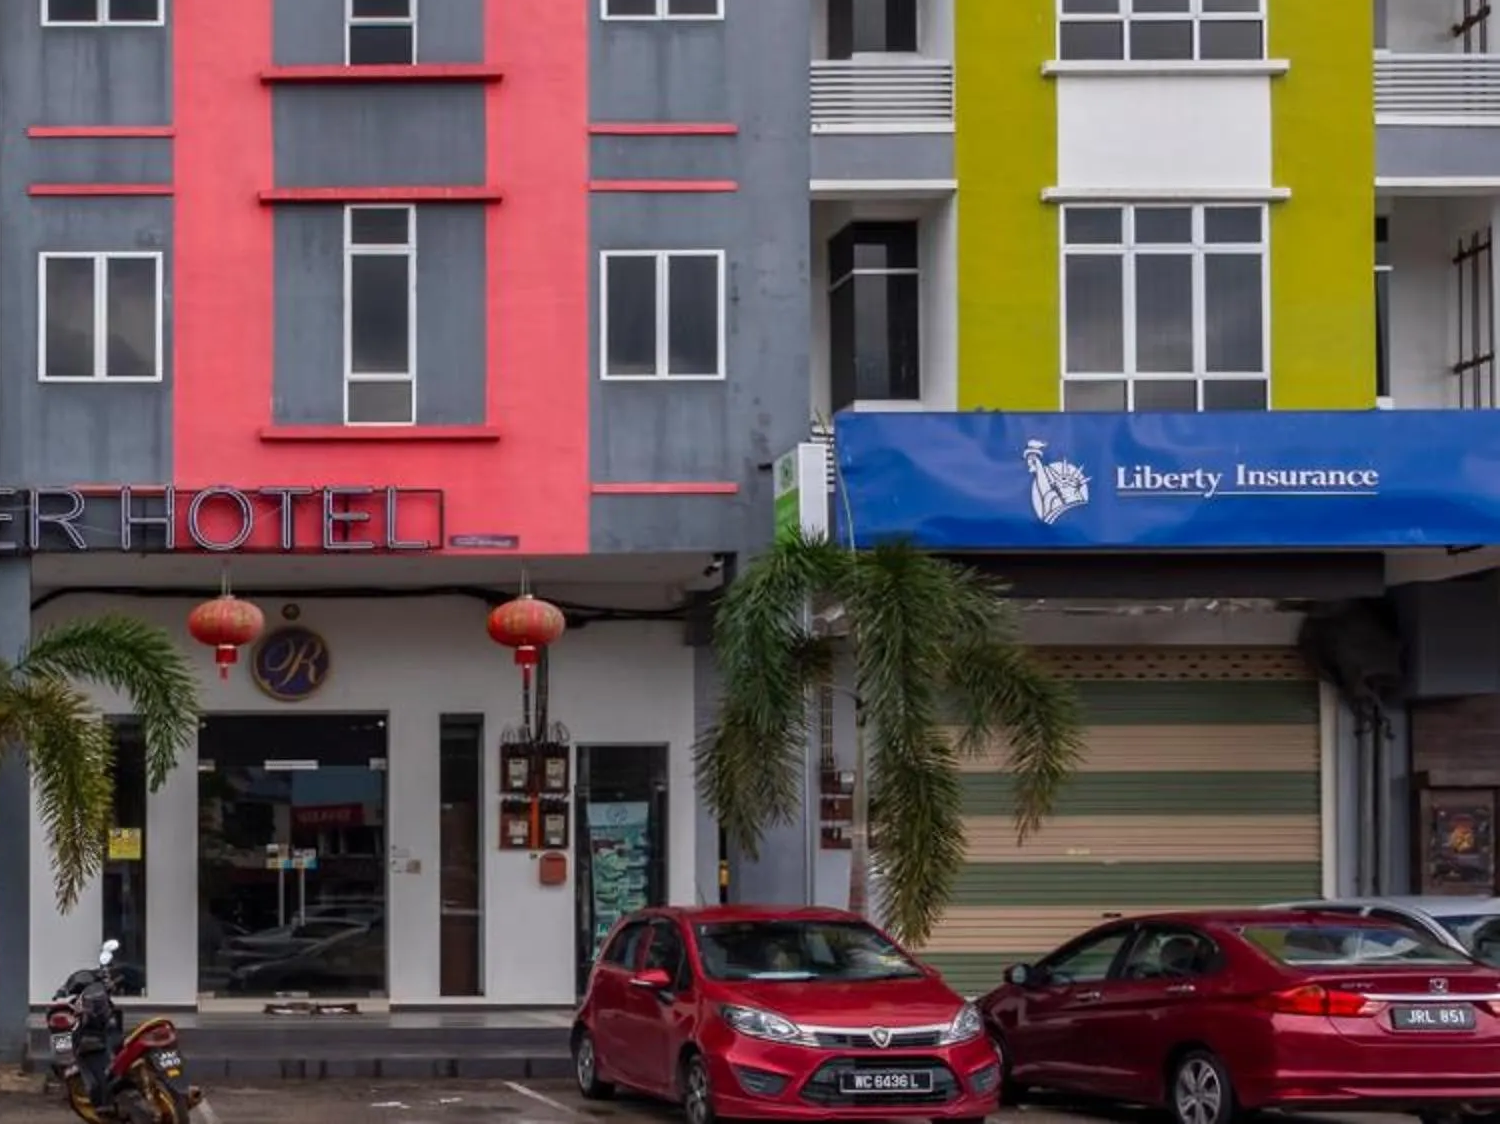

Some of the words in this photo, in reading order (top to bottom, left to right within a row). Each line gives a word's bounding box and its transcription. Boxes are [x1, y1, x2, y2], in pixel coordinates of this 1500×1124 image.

[1116, 465, 1222, 497] Liberty
[1236, 463, 1379, 486] Insurance
[120, 485, 432, 551] HOTEL
[1408, 1009, 1436, 1024] JRL
[1439, 1009, 1466, 1024] 851
[855, 1074, 873, 1089] WC
[910, 1074, 919, 1088] L
